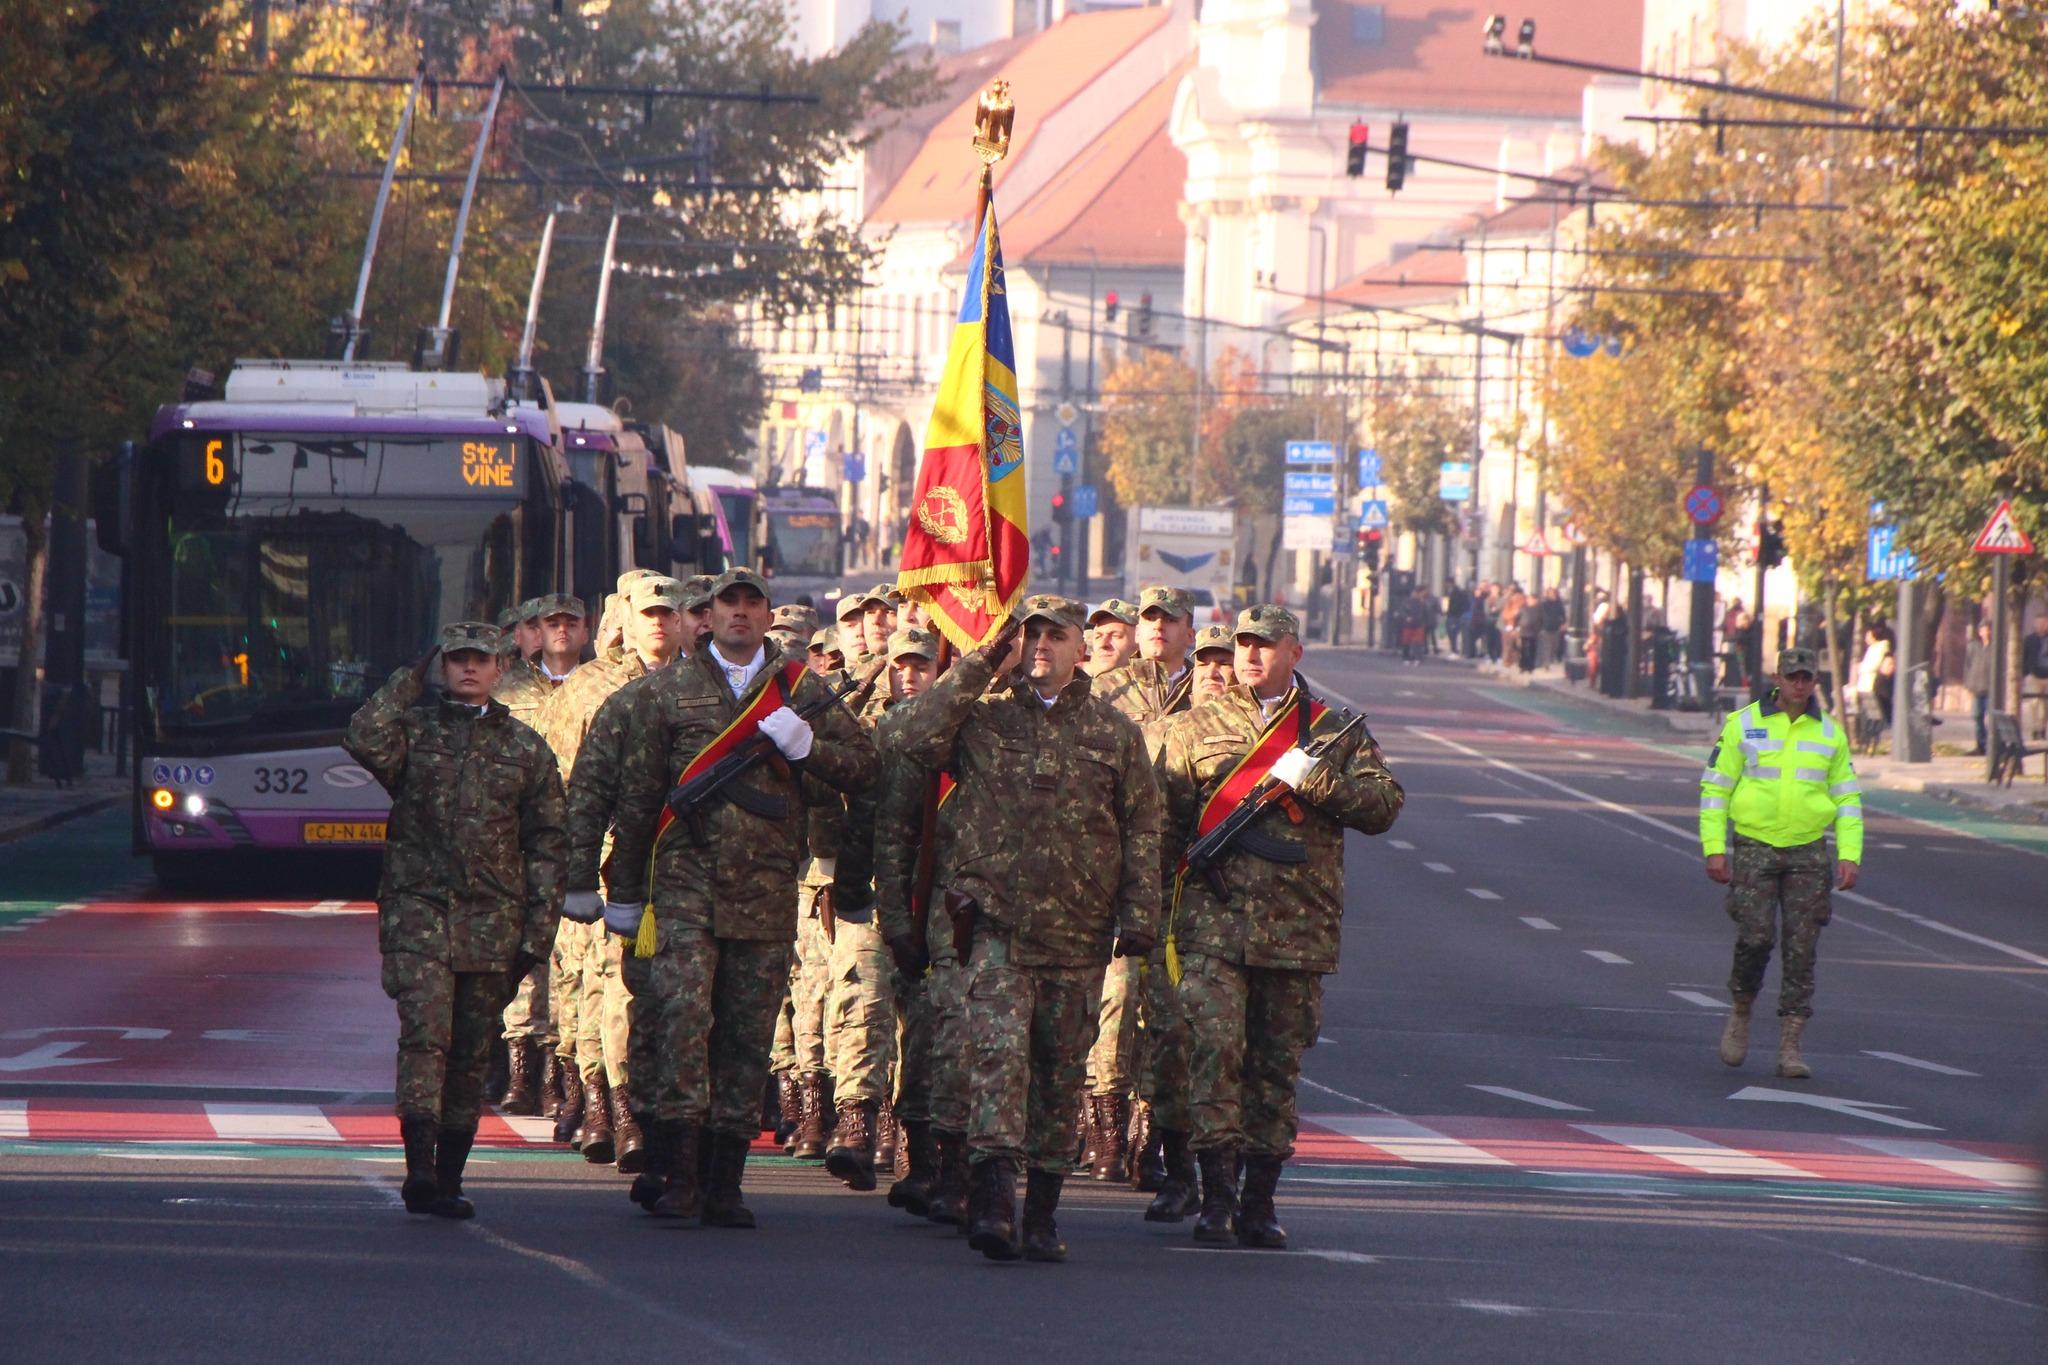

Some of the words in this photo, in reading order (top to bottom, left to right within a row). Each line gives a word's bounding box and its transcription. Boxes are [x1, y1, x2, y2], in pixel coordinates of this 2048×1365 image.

[207, 440, 224, 485] 6
[463, 442, 503, 465] Str.
[463, 464, 513, 486] VINE
[254, 767, 308, 794] 332
[316, 825, 355, 839] CJ-N
